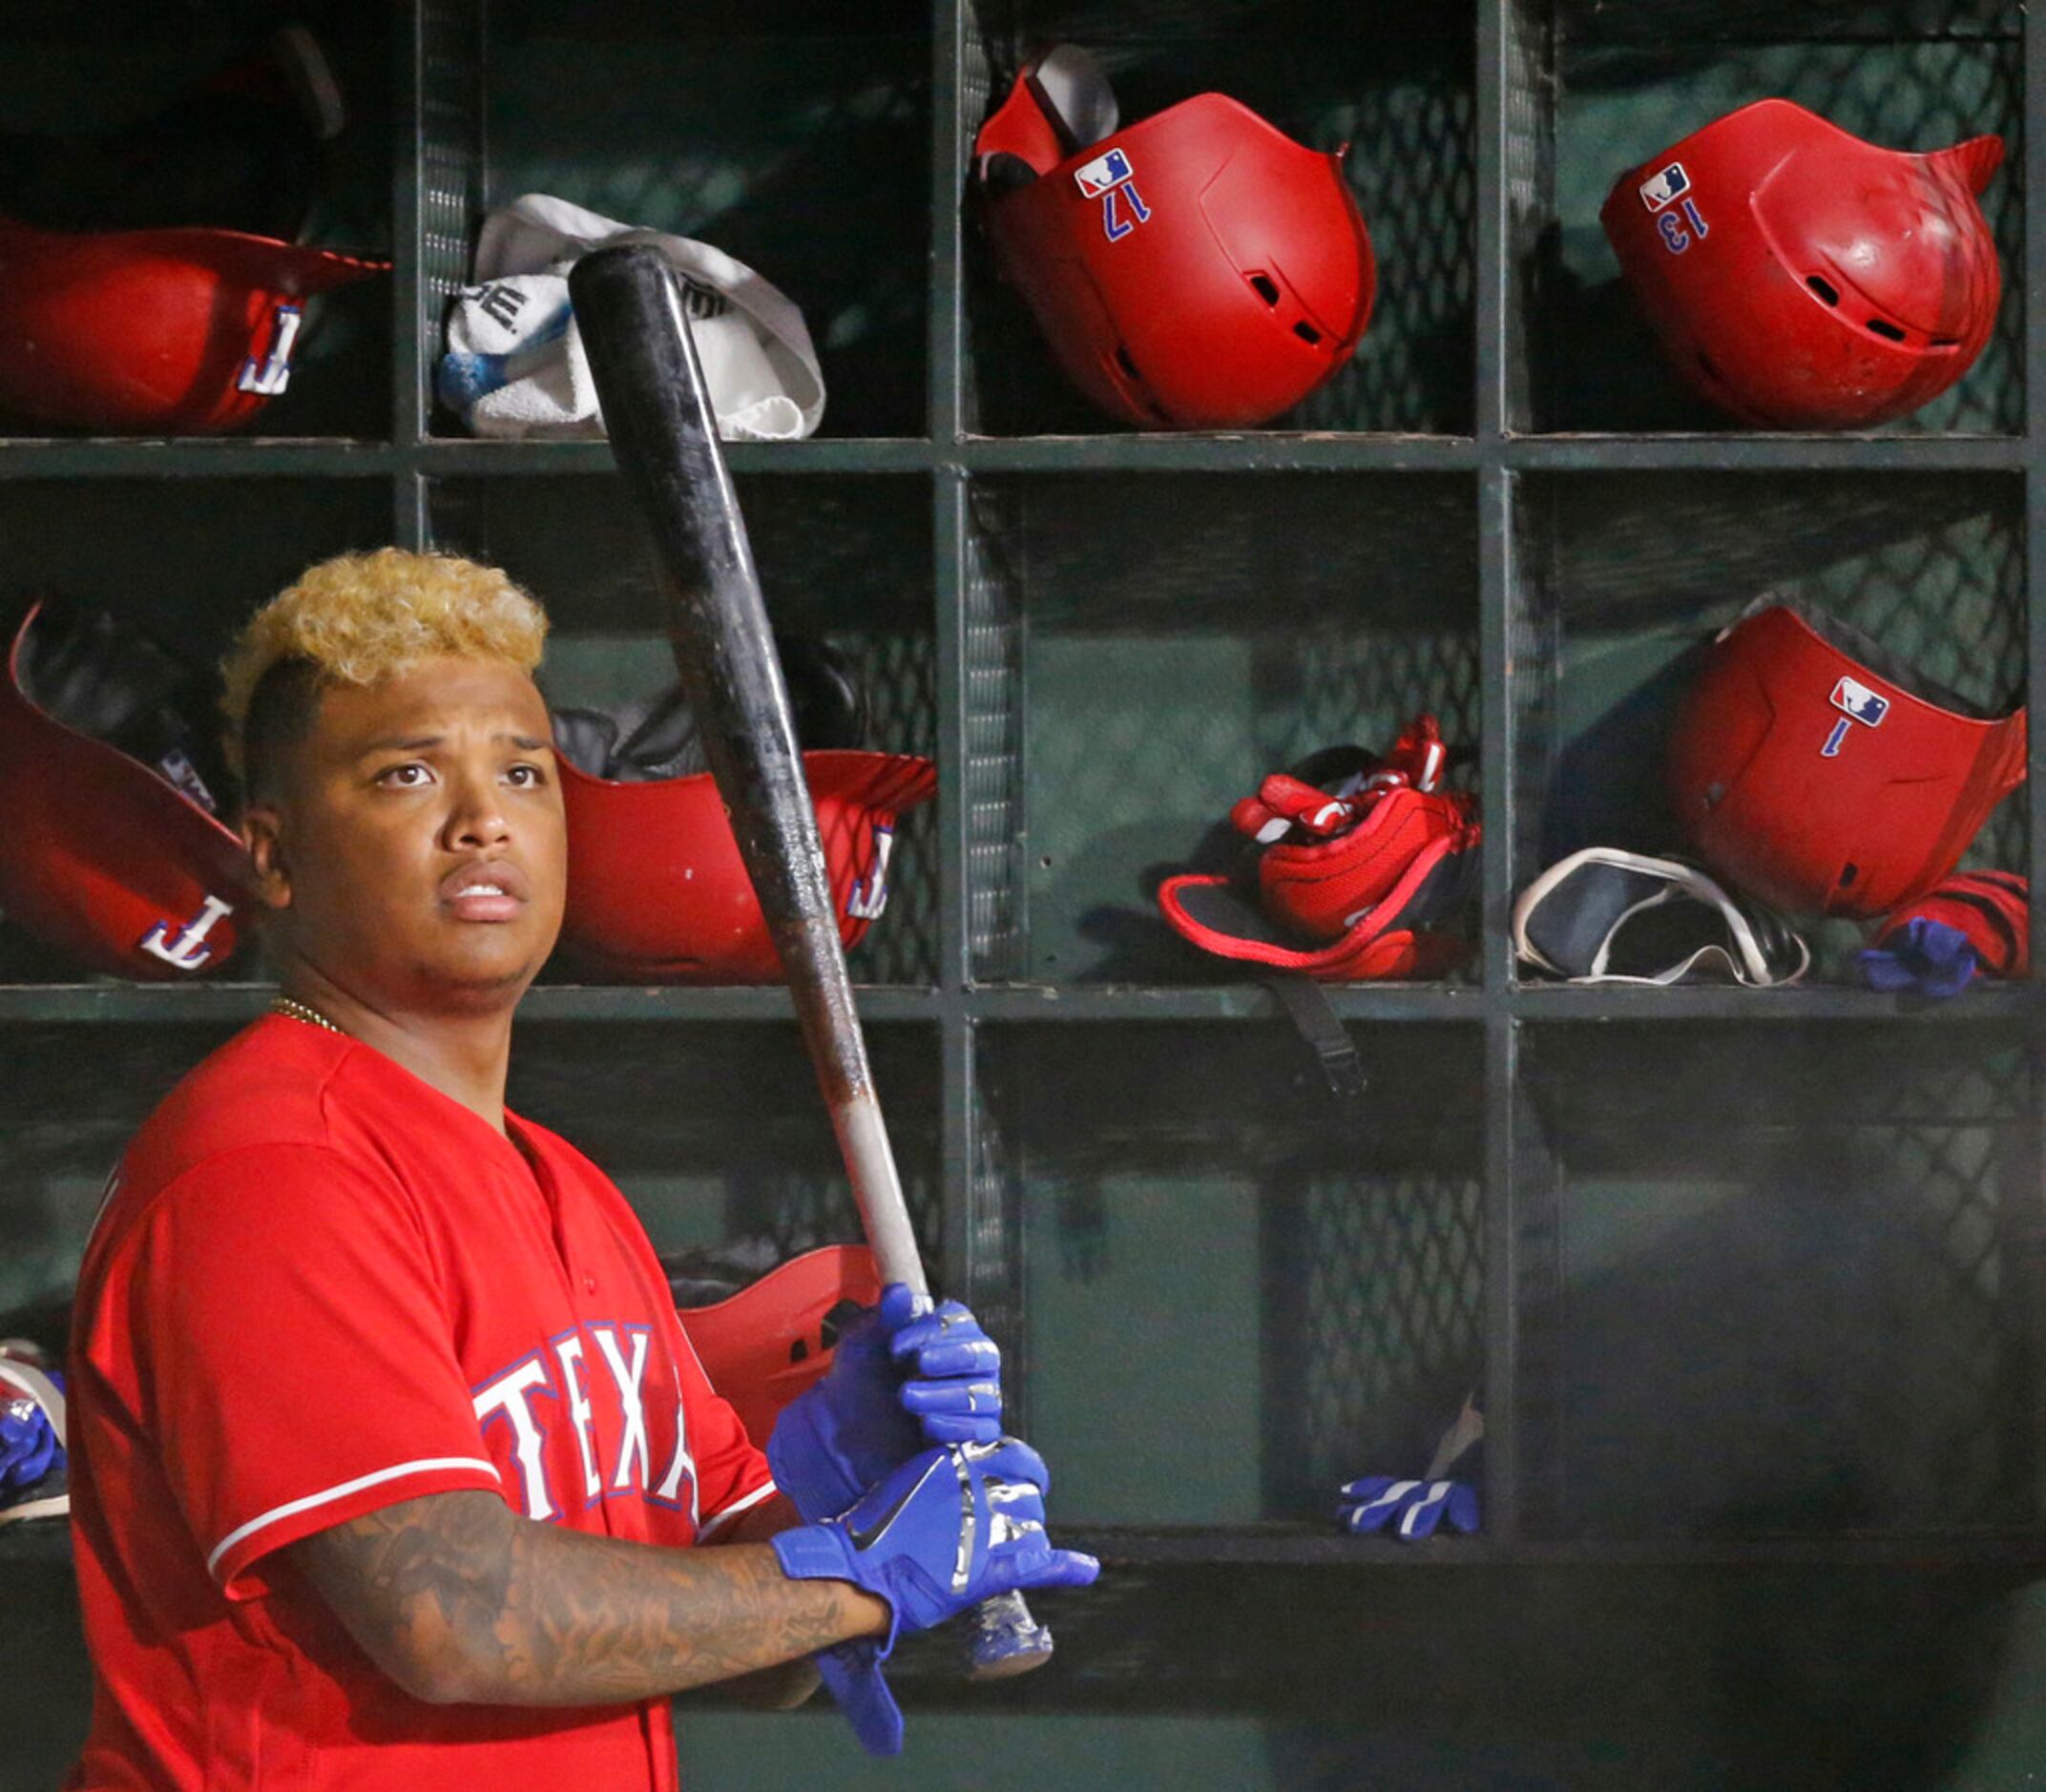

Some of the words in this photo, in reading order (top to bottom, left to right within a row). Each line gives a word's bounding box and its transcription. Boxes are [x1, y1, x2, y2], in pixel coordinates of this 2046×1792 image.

[1103, 179, 1151, 243] 17
[1657, 197, 1709, 255] 13
[139, 894, 234, 970] T
